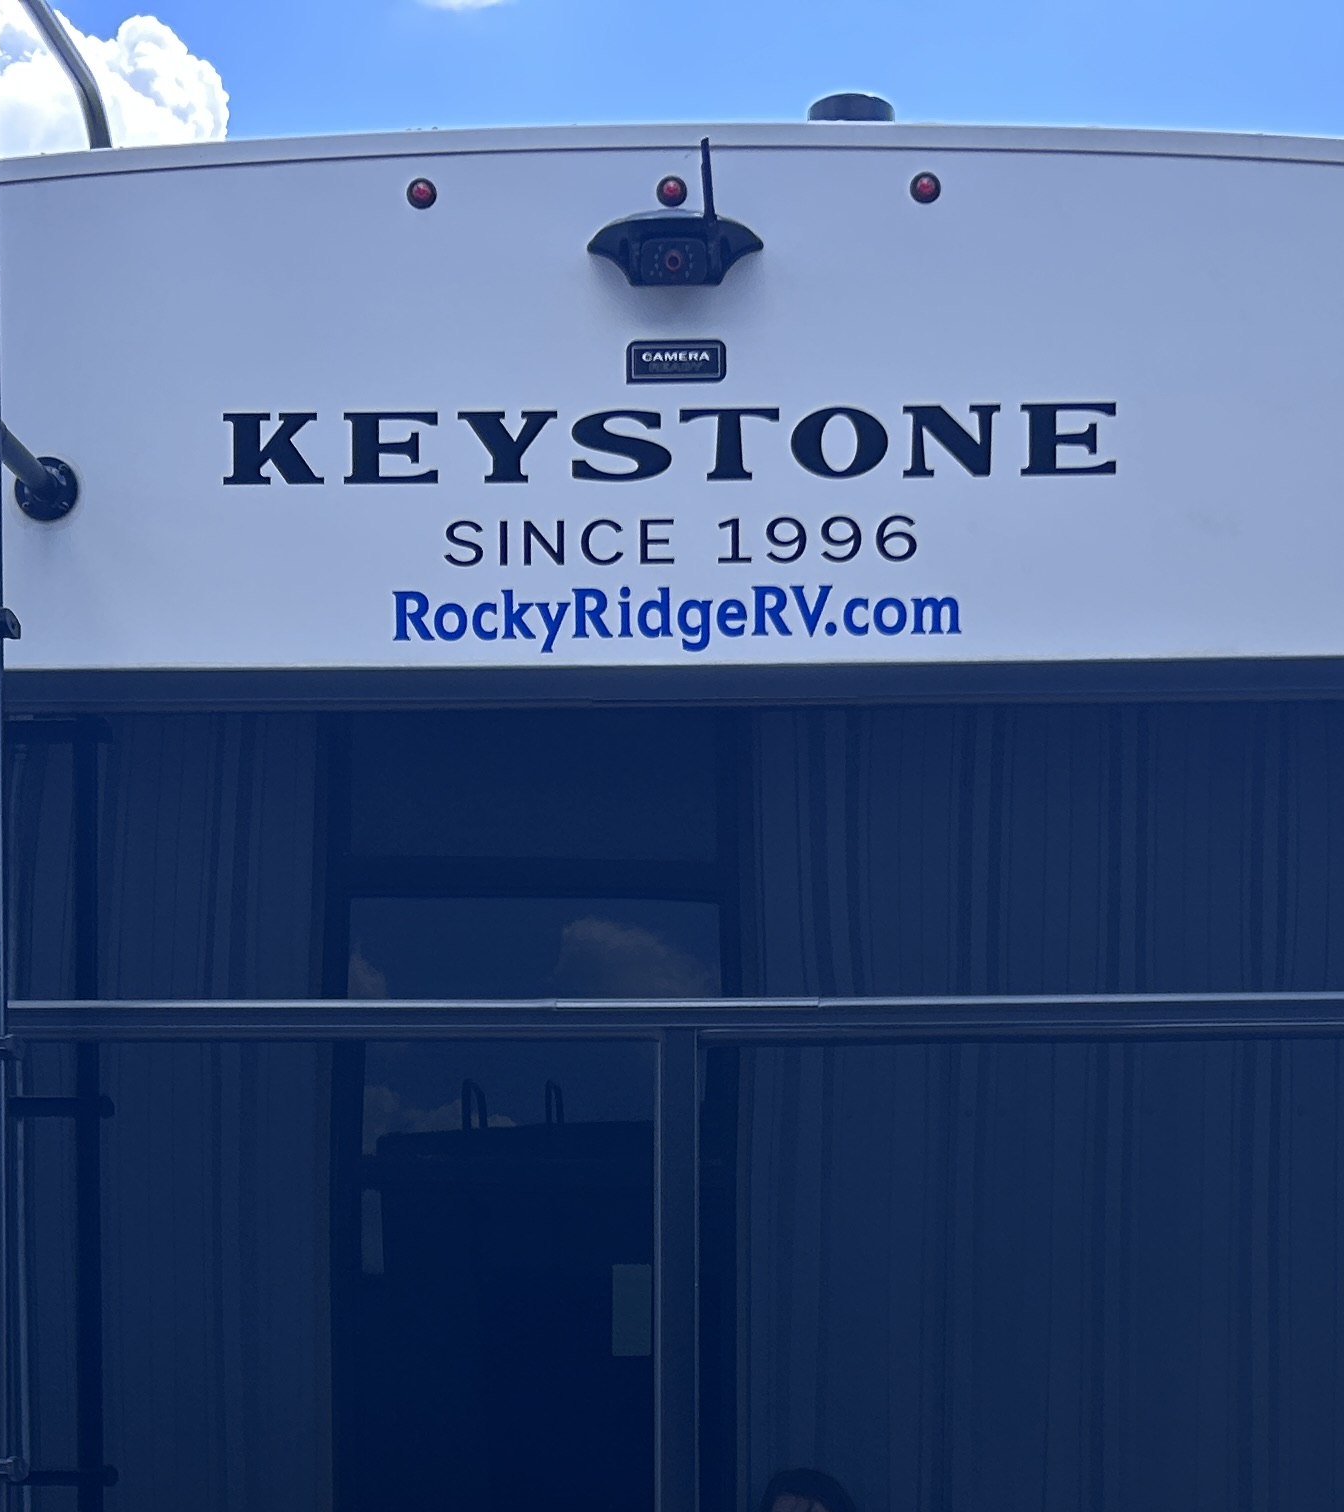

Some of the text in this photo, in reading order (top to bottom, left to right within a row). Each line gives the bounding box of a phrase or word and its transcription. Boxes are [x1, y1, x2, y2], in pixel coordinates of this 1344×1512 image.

[642, 351, 710, 362] CAMERA
[223, 402, 1116, 486] KEYSTONE
[443, 515, 918, 567] SINCE 1996
[393, 585, 961, 653] RockyRidgeRV.com
